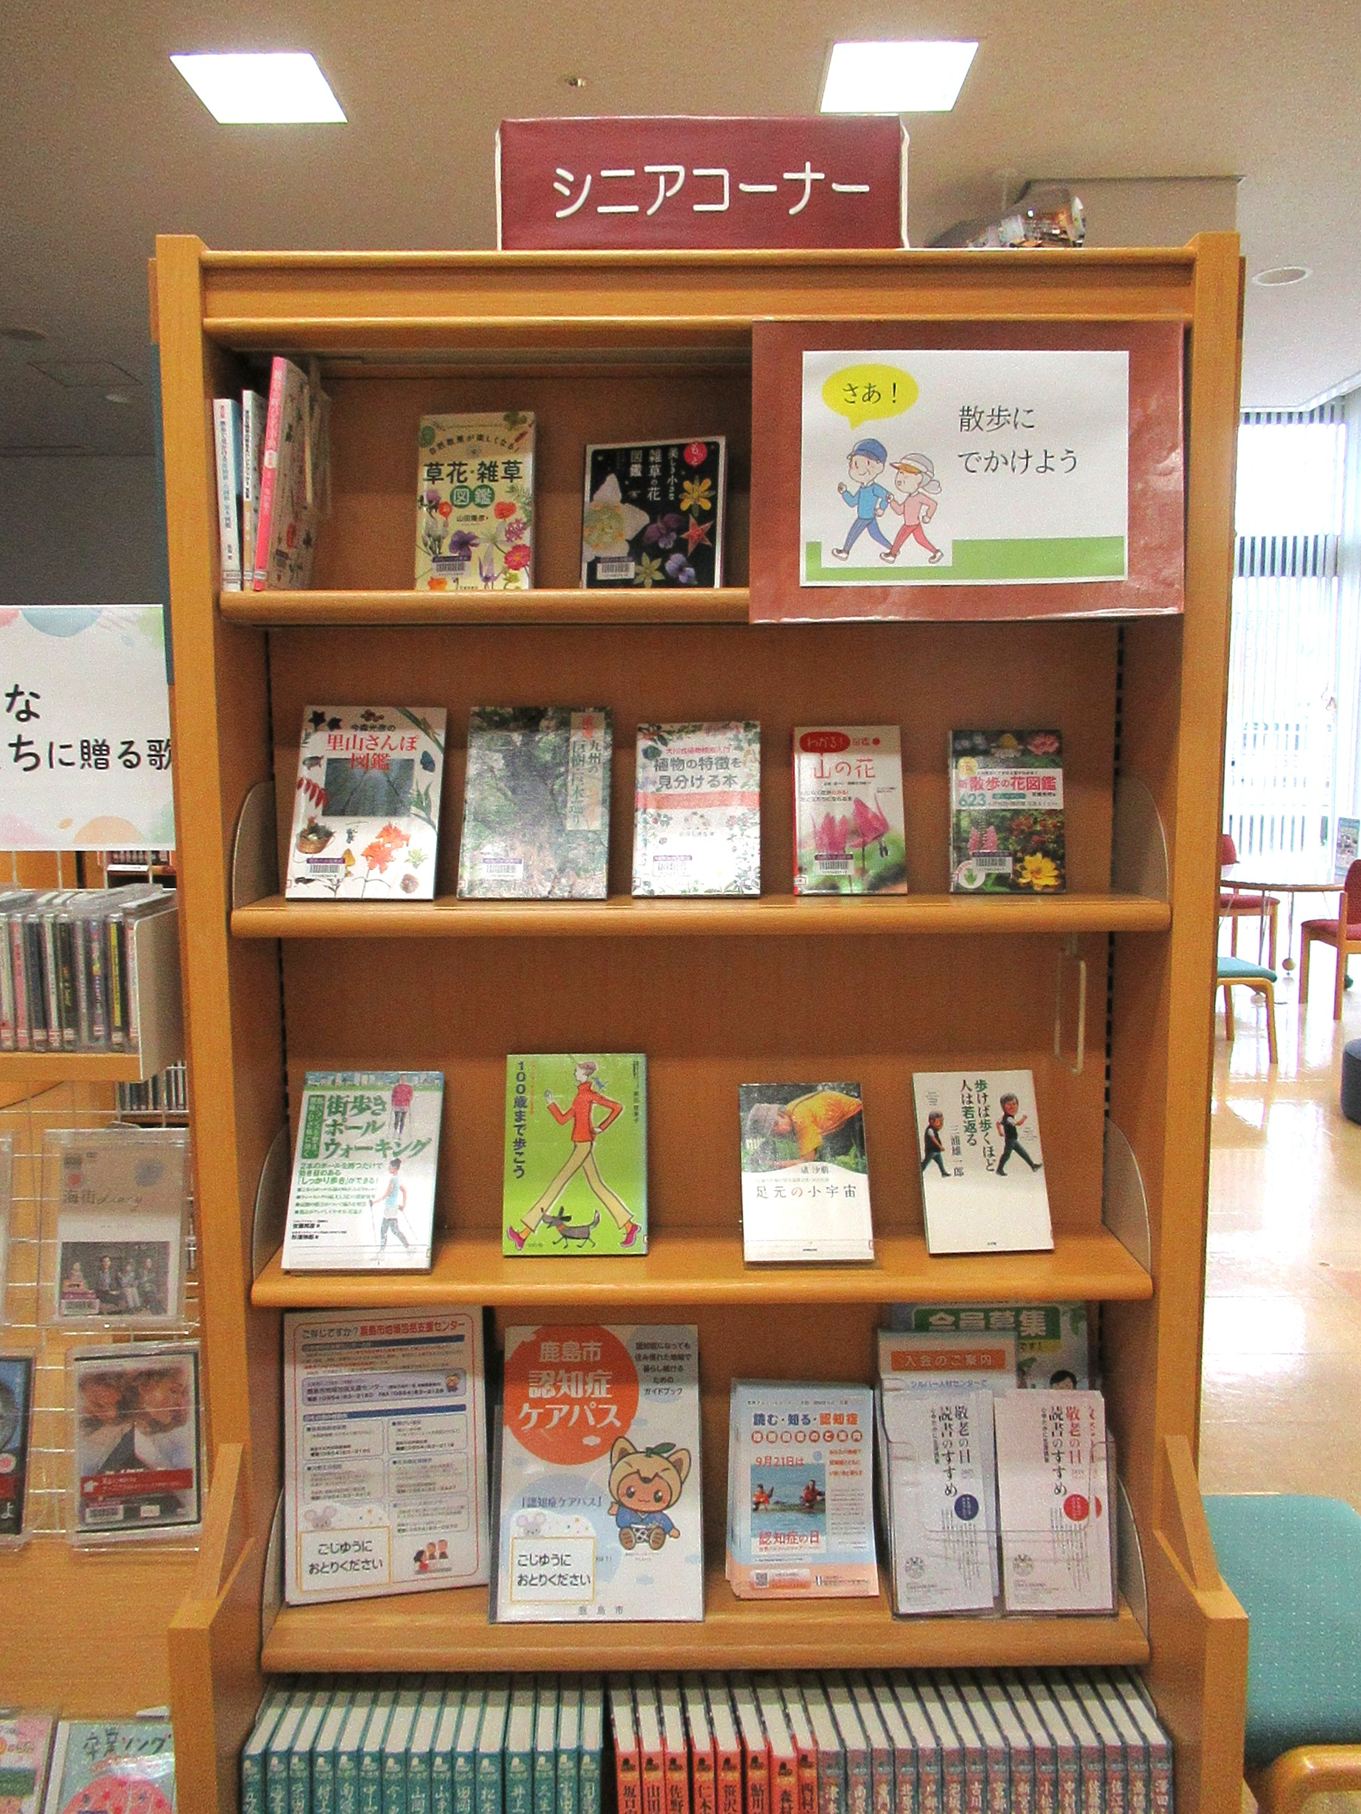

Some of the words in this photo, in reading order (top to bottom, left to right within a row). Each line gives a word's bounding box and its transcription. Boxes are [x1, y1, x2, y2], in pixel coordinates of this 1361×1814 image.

[552, 161, 870, 217] シニアコーナー
[841, 382, 899, 405] さあ！
[958, 405, 1037, 433] 散歩に
[424, 460, 523, 484] 草花・雑草
[958, 447, 1080, 476] でかけよう
[647, 449, 662, 501] 雑草の花
[452, 487, 493, 505] 図鑑
[5, 684, 40, 722] な
[326, 733, 421, 751] 里山さんぽ
[350, 752, 392, 771] 図鑑
[656, 757, 742, 773] 植物の特徴を
[814, 758, 876, 779] 山の花
[659, 774, 738, 790] 見分ける本
[959, 793, 987, 807] 623
[326, 1094, 387, 1117] 街歩き
[960, 1079, 978, 1147] 人は若返る
[974, 1079, 996, 1172] 歩けば歩くほど
[323, 1137, 433, 1160] ウォーキング
[756, 1185, 858, 1199] 足元の小宇宙
[538, 1341, 604, 1363] 鹿島市
[904, 1354, 993, 1367] 入会のご案内
[528, 1371, 613, 1398] 認知症
[519, 1402, 622, 1431] ケアパス
[955, 1405, 971, 1464] 敬老の日
[1066, 1405, 1081, 1464] 敬老の日
[308, 1559, 384, 1576] おとりください
[517, 1573, 591, 1587] おとりください
